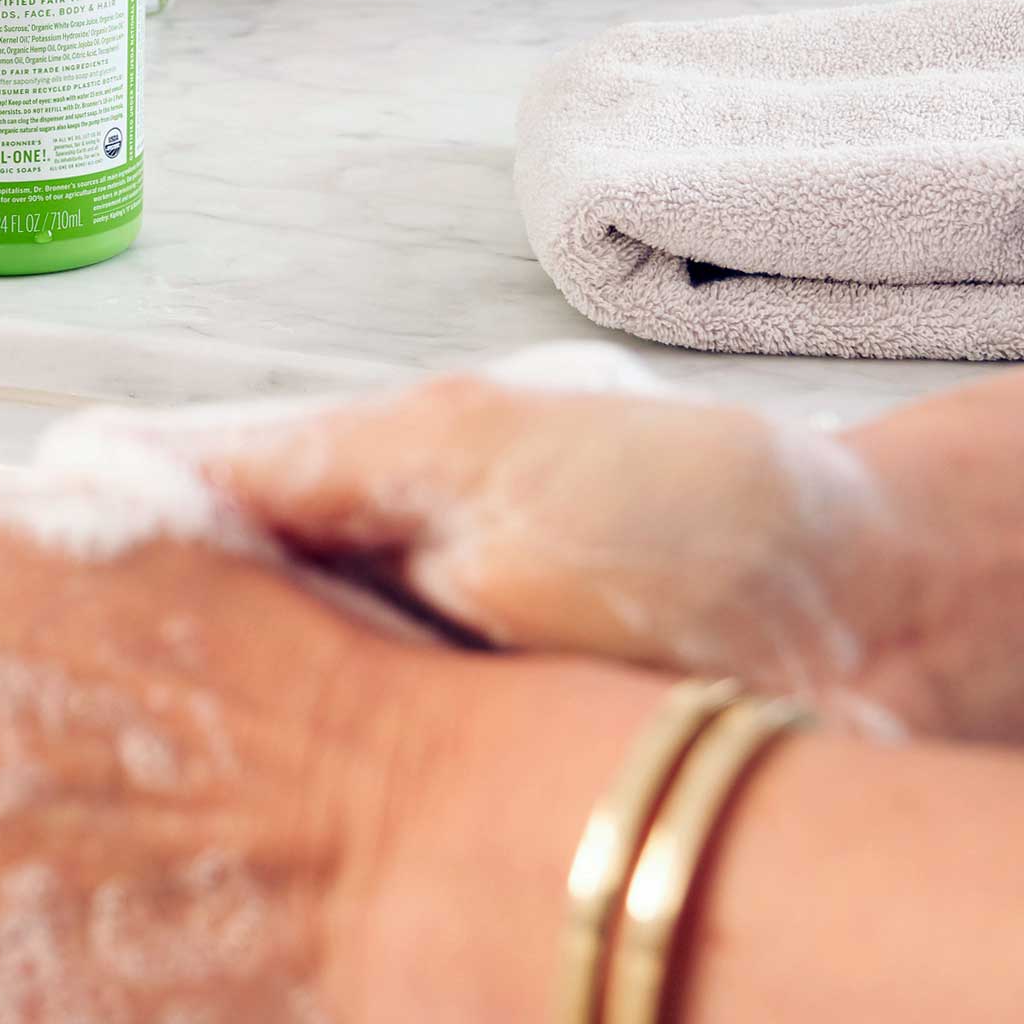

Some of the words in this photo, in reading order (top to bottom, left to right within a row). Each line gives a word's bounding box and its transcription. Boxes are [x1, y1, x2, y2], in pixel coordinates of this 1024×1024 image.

[59, 6, 85, 15] BODY
[97, 0, 115, 9] HAIR
[32, 66, 58, 74] TRADE
[63, 58, 108, 71] INGREDIENTS
[33, 85, 71, 94] RECYCLED
[74, 80, 100, 90] PLASTIC
[45, 182, 76, 192] Bronner's
[11, 214, 24, 233] FL
[26, 214, 40, 232] OZ
[51, 208, 83, 230] 710mL
